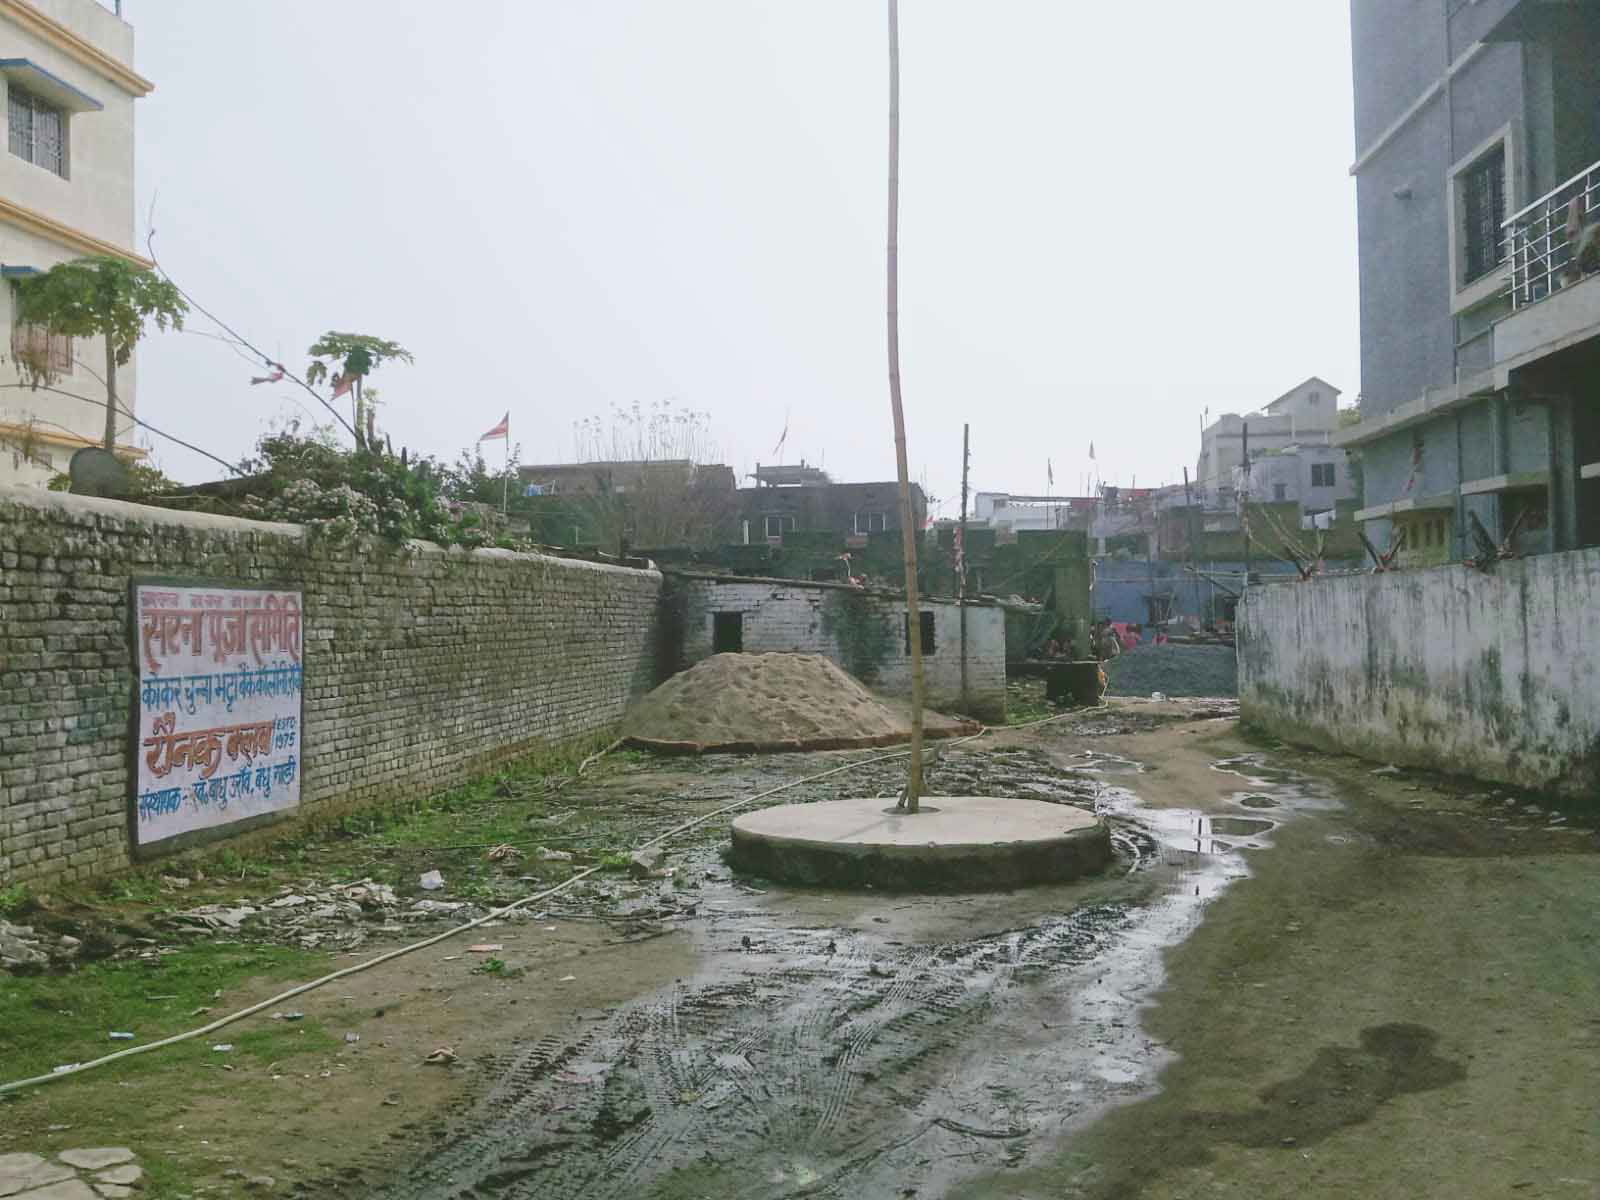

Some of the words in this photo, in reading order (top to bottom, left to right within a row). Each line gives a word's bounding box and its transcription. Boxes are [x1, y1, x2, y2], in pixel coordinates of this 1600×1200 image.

[142, 608, 205, 671] सरना
[207, 608, 247, 664] पूजा
[250, 594, 302, 665] समिति
[143, 712, 225, 778] रौनक
